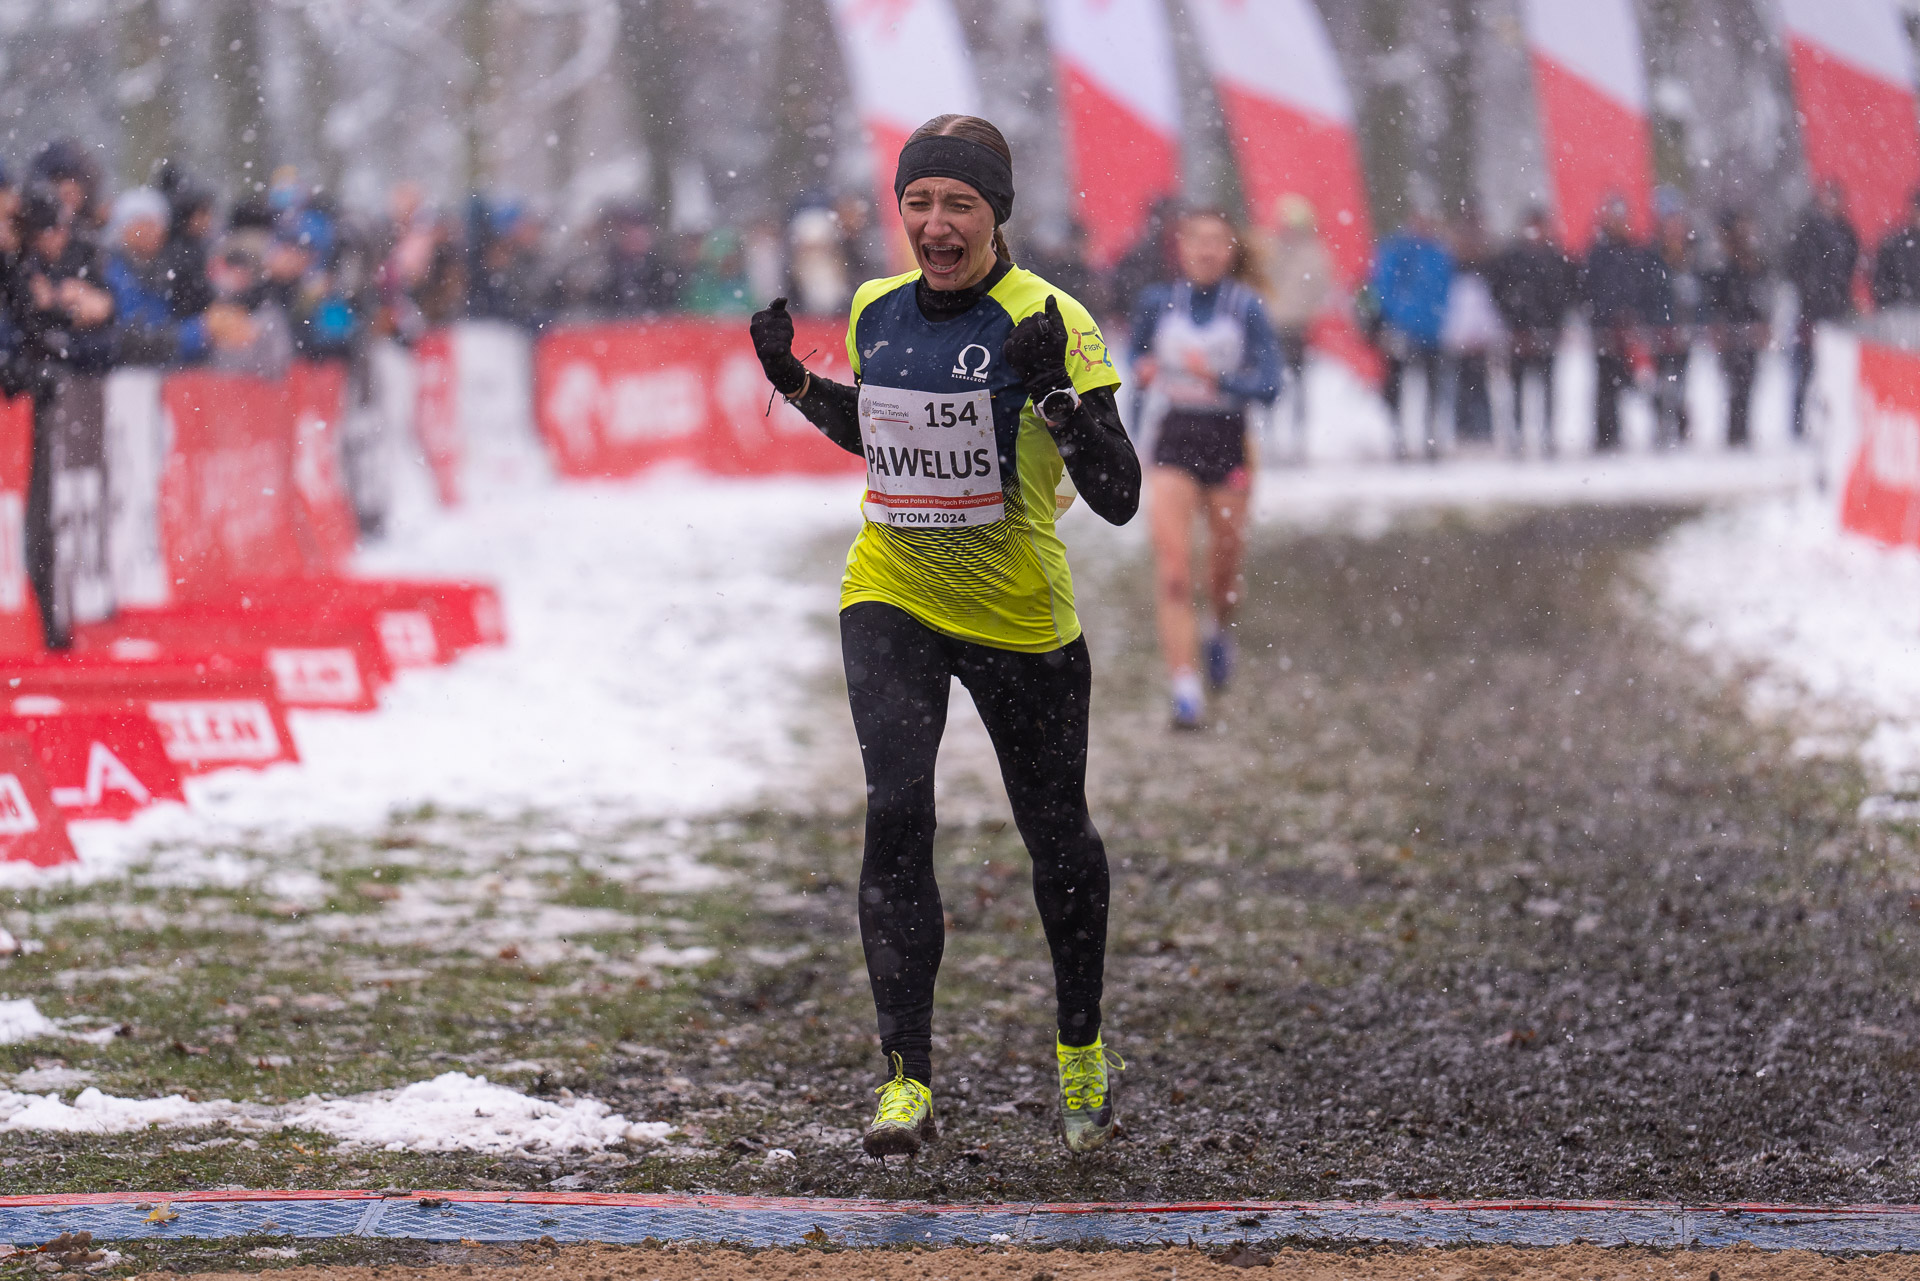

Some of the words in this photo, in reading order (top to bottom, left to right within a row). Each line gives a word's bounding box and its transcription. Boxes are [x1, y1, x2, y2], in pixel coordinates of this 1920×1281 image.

[872, 400, 900, 410] Ministerstwo
[871, 407, 885, 415] Sportu
[888, 409, 910, 418] Turystyki
[924, 401, 979, 428] 154
[866, 443, 992, 480] PAWELUS
[934, 498, 958, 507] Biegach
[933, 512, 967, 523] 2024
